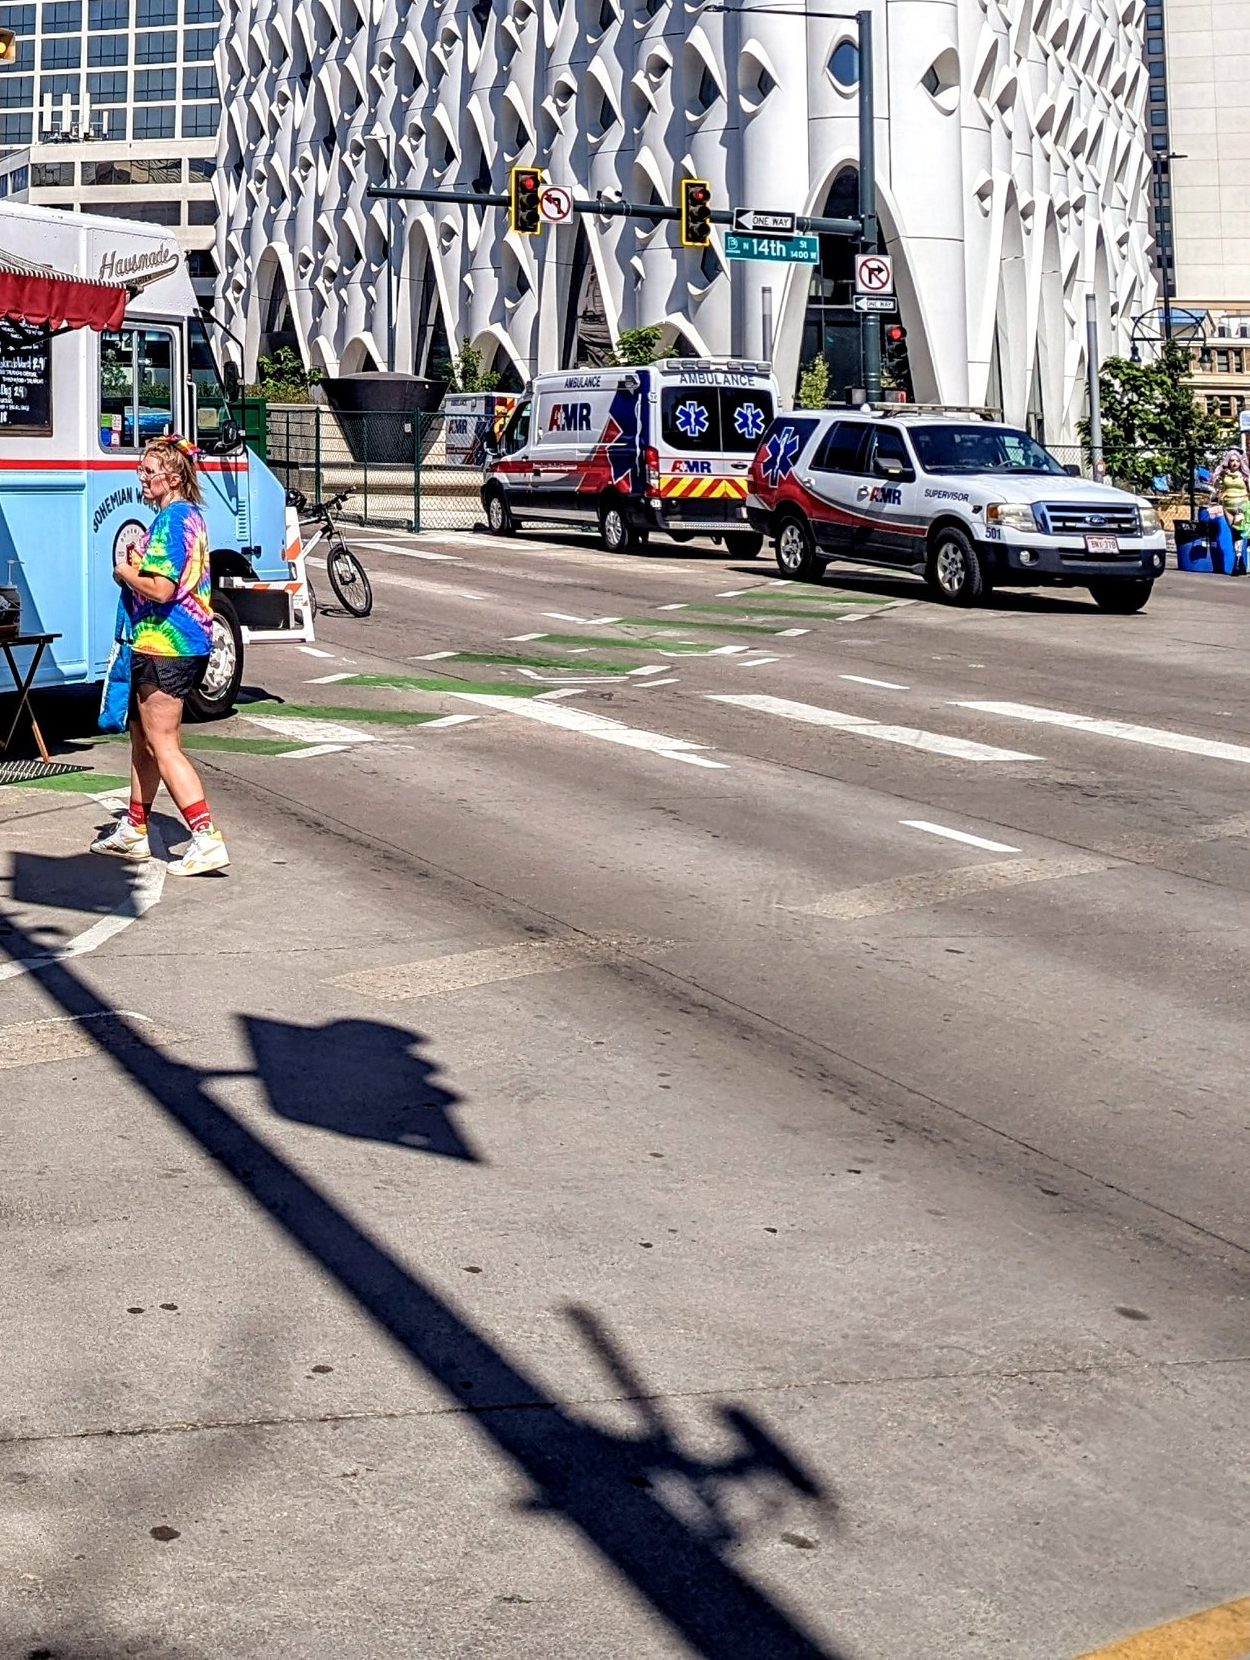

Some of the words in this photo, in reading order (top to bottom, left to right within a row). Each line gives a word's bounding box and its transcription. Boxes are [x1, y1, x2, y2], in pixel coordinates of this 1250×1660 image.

[753, 217, 769, 225] ONE
[773, 218, 788, 226] WAY
[752, 239, 786, 257] 14th
[99, 242, 169, 279] Hausmade
[790, 251, 808, 259] 1400
[564, 376, 601, 388] AMBULANCE
[680, 373, 755, 386] AMBULANCE
[549, 403, 591, 431] AMR
[671, 461, 712, 473] AMR
[870, 487, 901, 504] AMR
[924, 489, 969, 502] SUPERVISOR
[93, 487, 132, 533] BOHEMIAN
[985, 527, 1001, 539] 501
